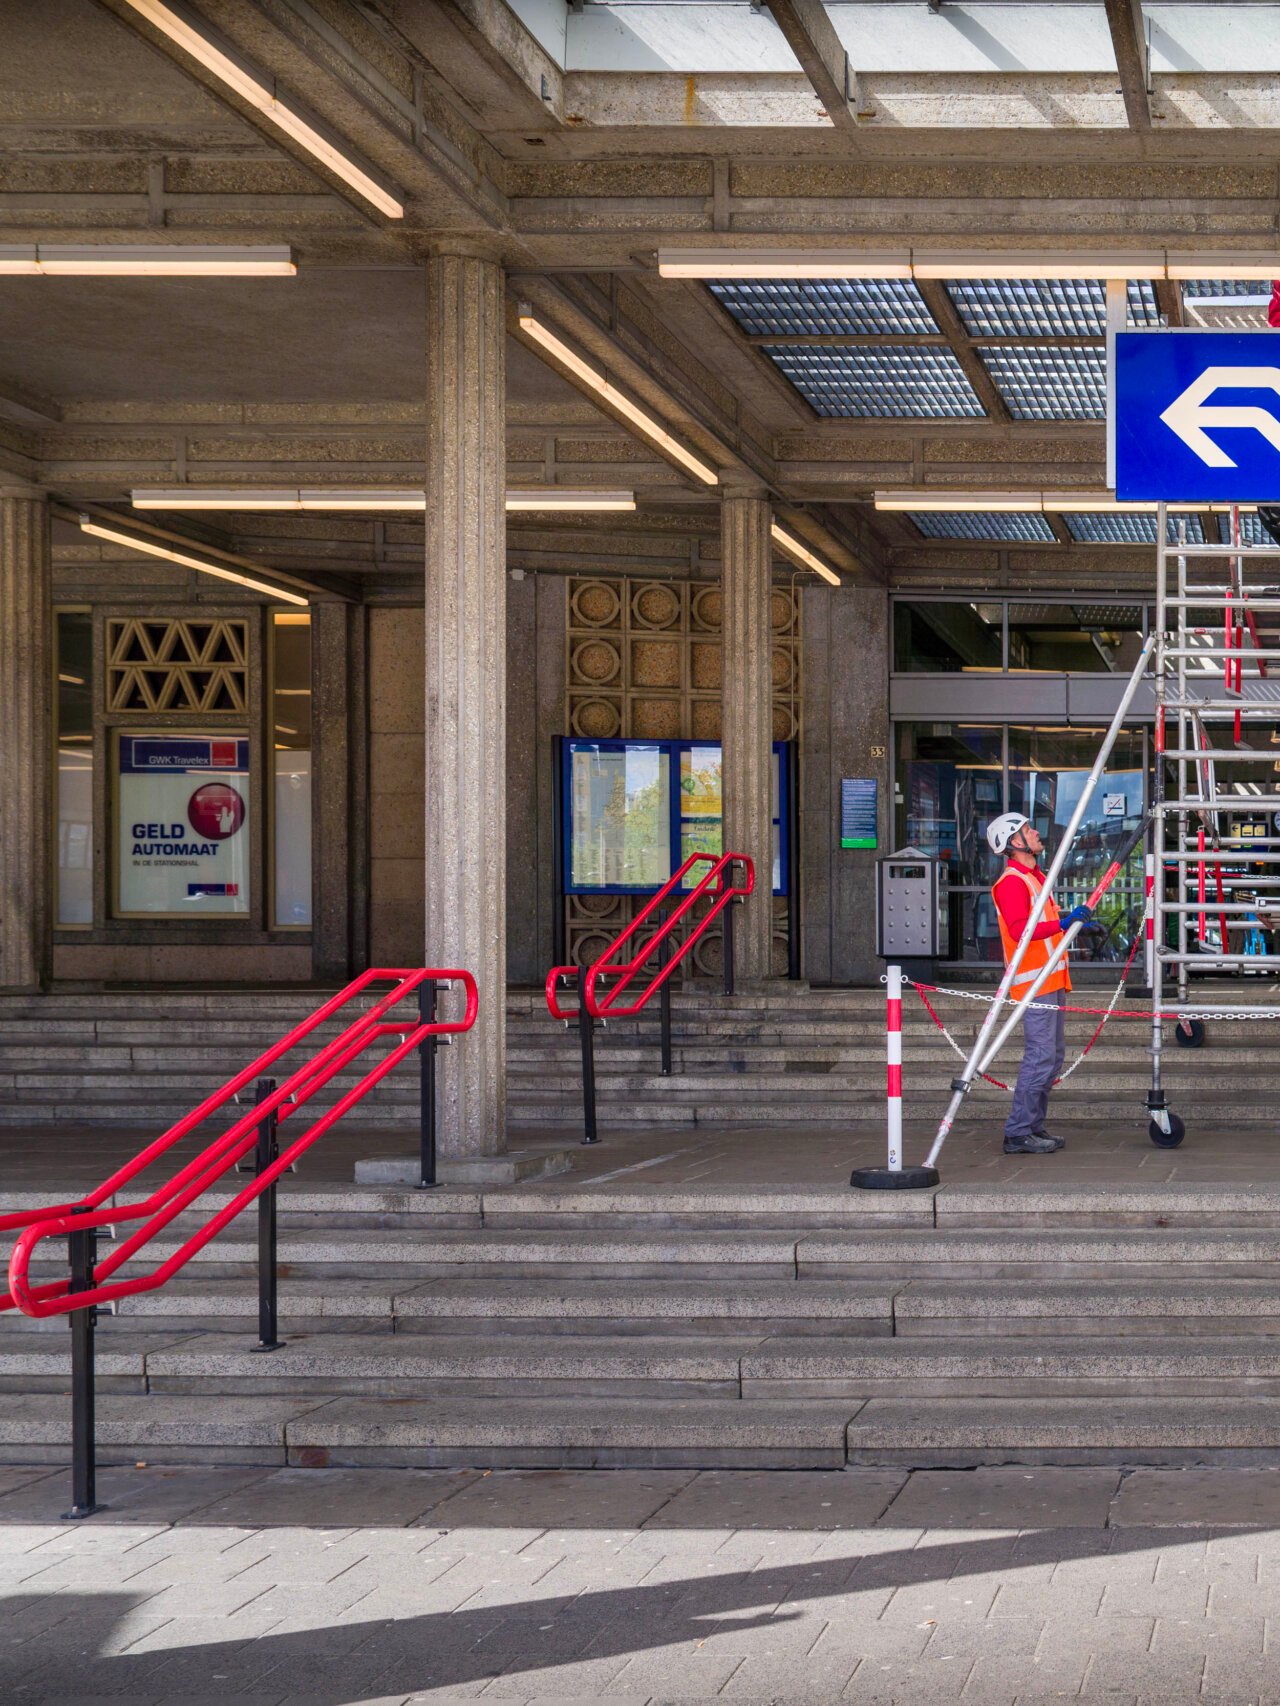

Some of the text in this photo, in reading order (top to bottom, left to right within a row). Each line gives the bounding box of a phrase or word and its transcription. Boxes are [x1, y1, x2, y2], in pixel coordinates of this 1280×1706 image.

[872, 747, 885, 757] 33
[148, 755, 209, 765] GWK Travelex
[132, 823, 185, 839] GELD
[132, 843, 219, 856] AUTOMAAT
